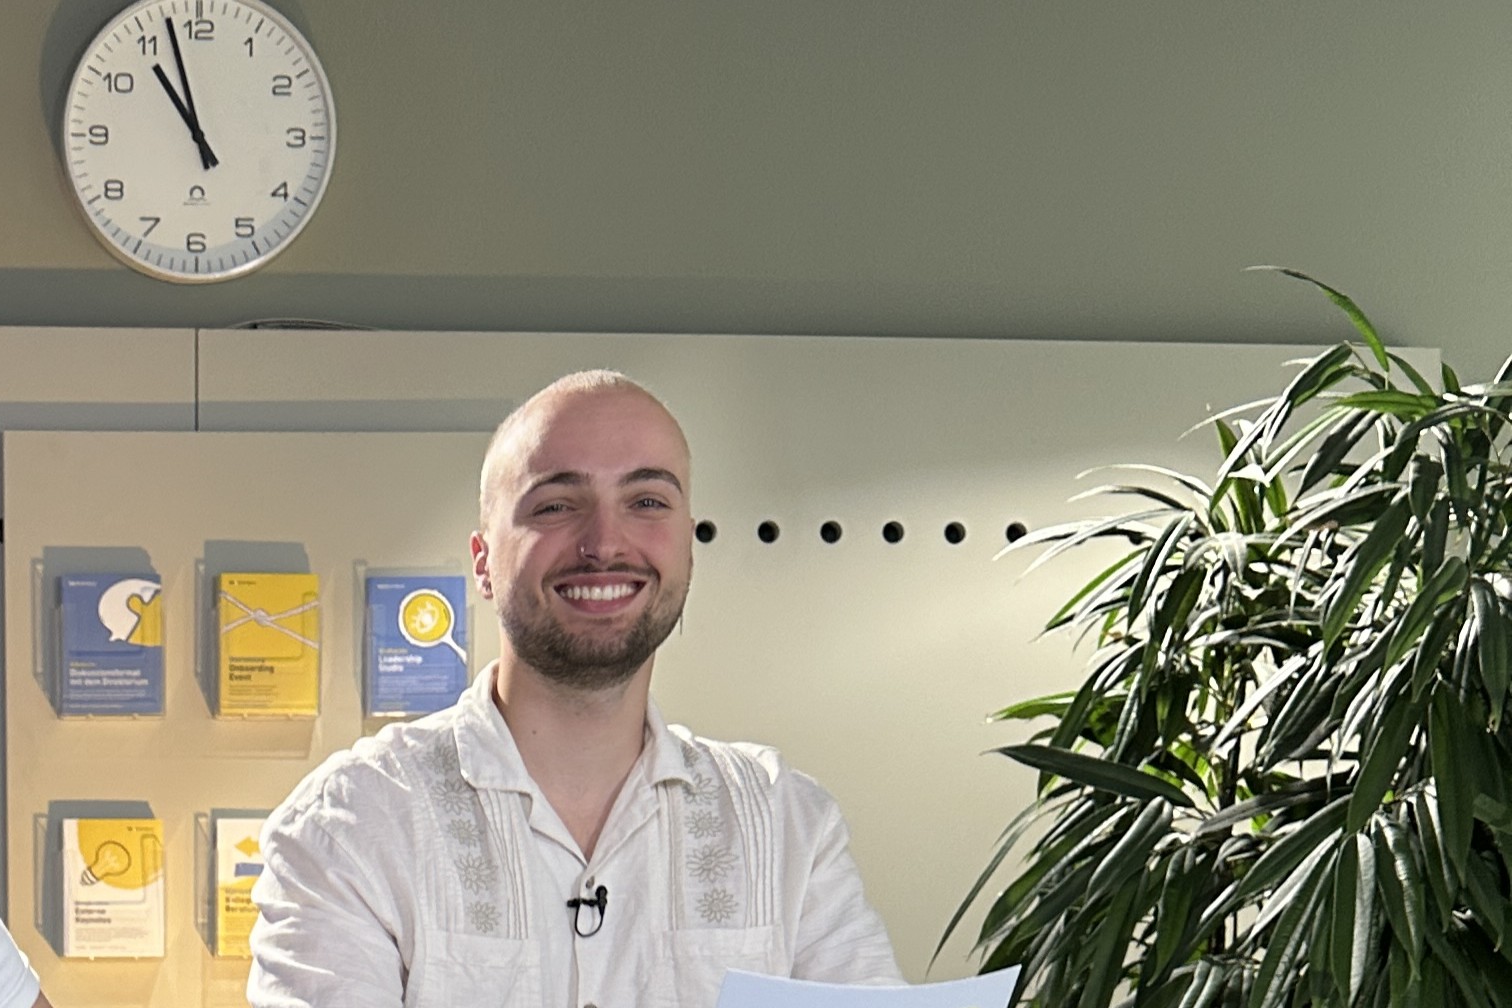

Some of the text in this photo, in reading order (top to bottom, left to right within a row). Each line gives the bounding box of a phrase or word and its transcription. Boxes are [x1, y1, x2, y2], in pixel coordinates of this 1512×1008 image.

[183, 19, 215, 41] 12
[137, 35, 158, 56] 11
[244, 37, 254, 57] 1
[102, 72, 134, 93] 10
[272, 75, 292, 96] 2
[88, 125, 109, 146] 9
[286, 128, 306, 148] 3
[104, 179, 124, 200] 8
[271, 181, 289, 201] 4
[139, 216, 160, 237] 7
[235, 217, 255, 238] 5
[186, 232, 206, 253] 6
